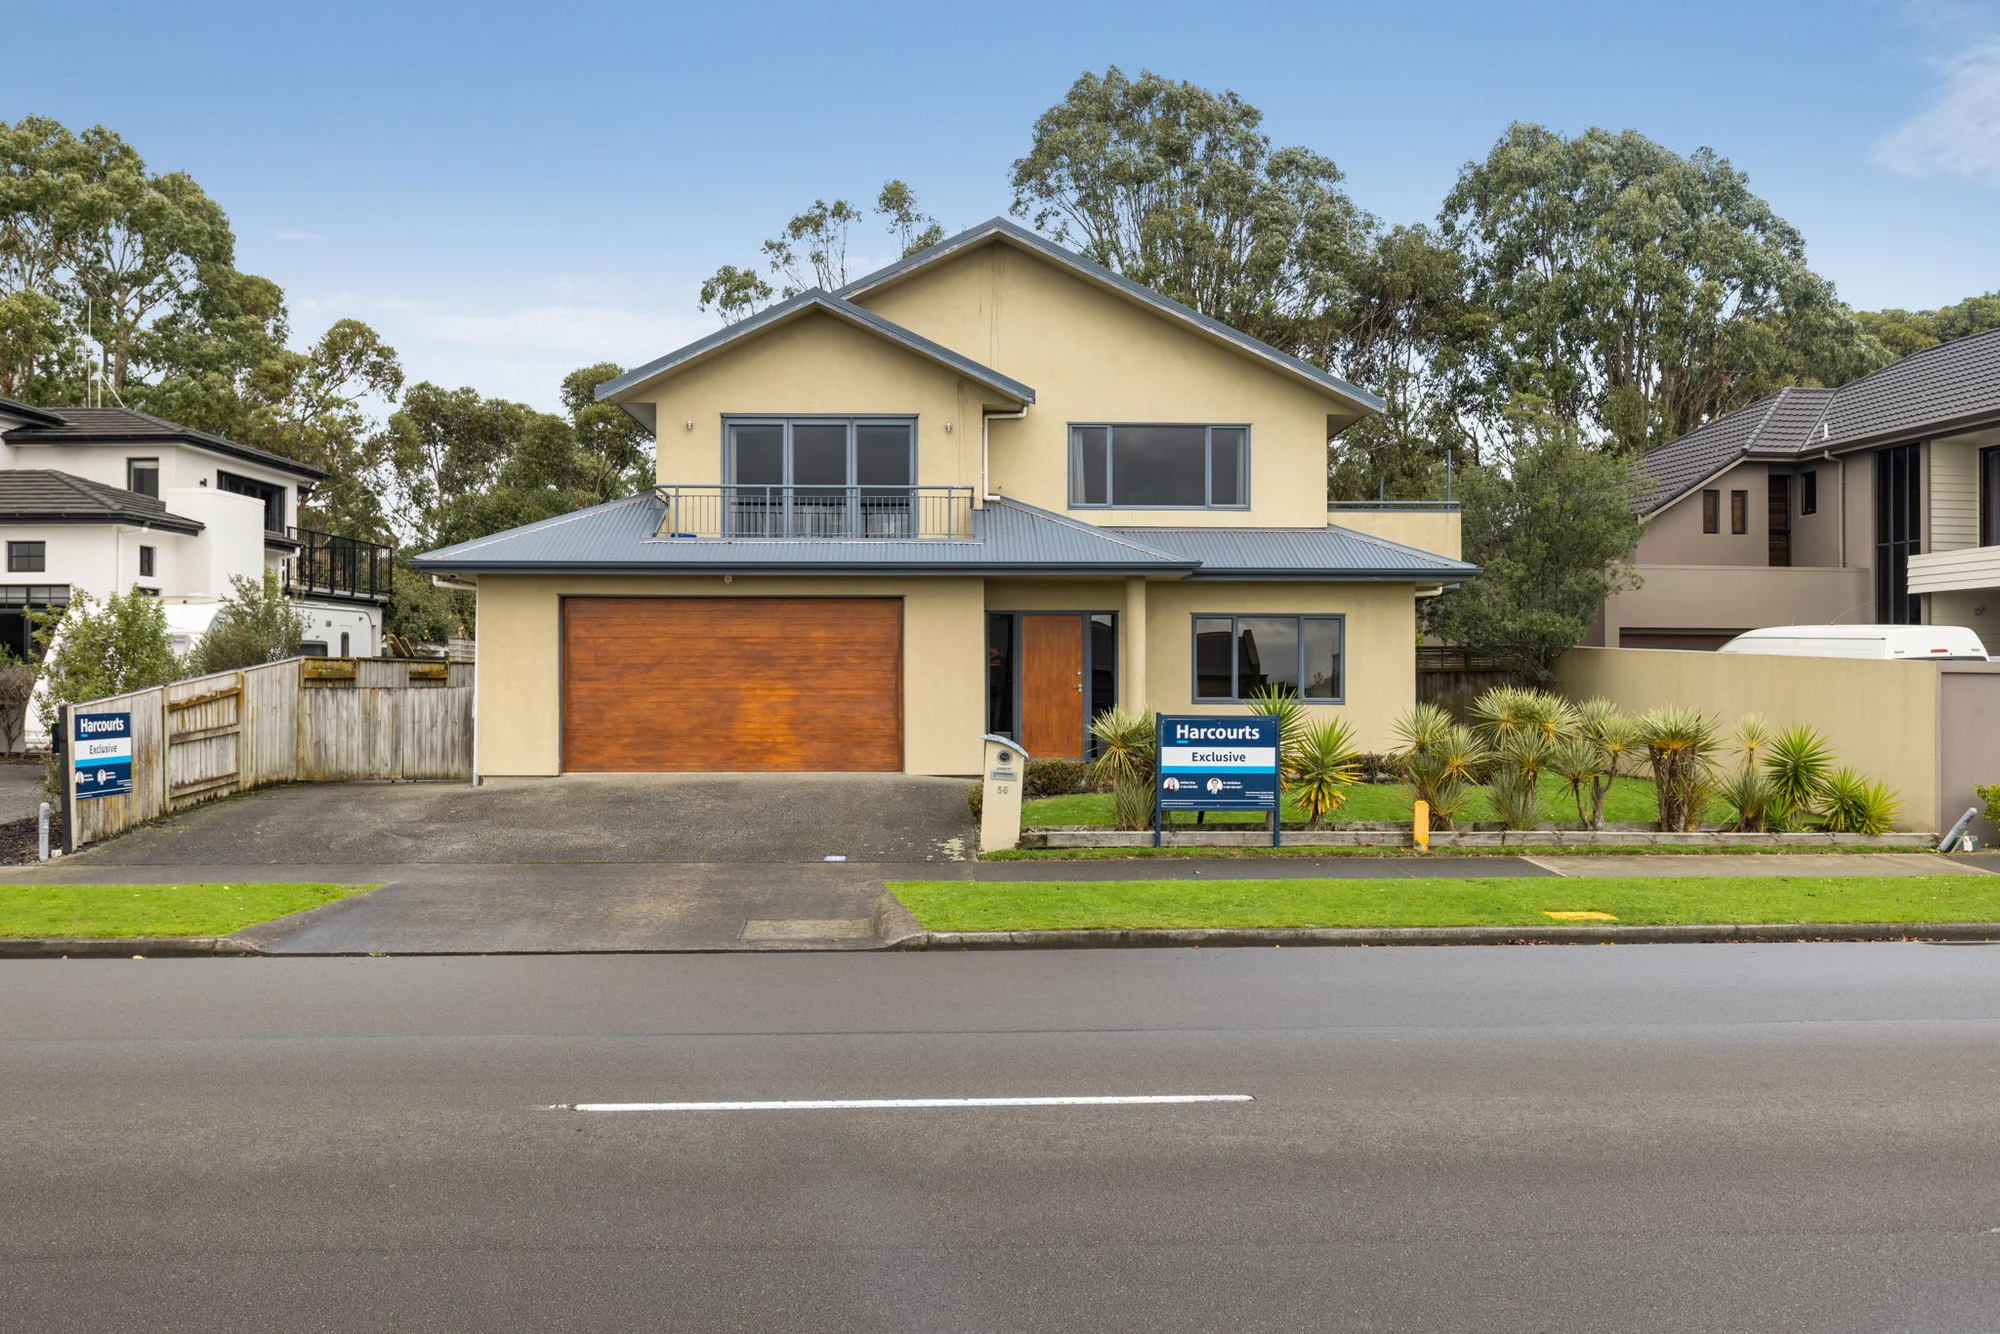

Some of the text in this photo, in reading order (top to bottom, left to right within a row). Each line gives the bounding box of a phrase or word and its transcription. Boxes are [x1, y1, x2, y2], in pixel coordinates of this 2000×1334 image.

[80, 717, 124, 733] Harcourts
[1176, 724, 1260, 740] Harcourts
[89, 743, 118, 755] Exclusive
[1191, 752, 1247, 762] Exclusive
[997, 786, 1009, 795] 56
